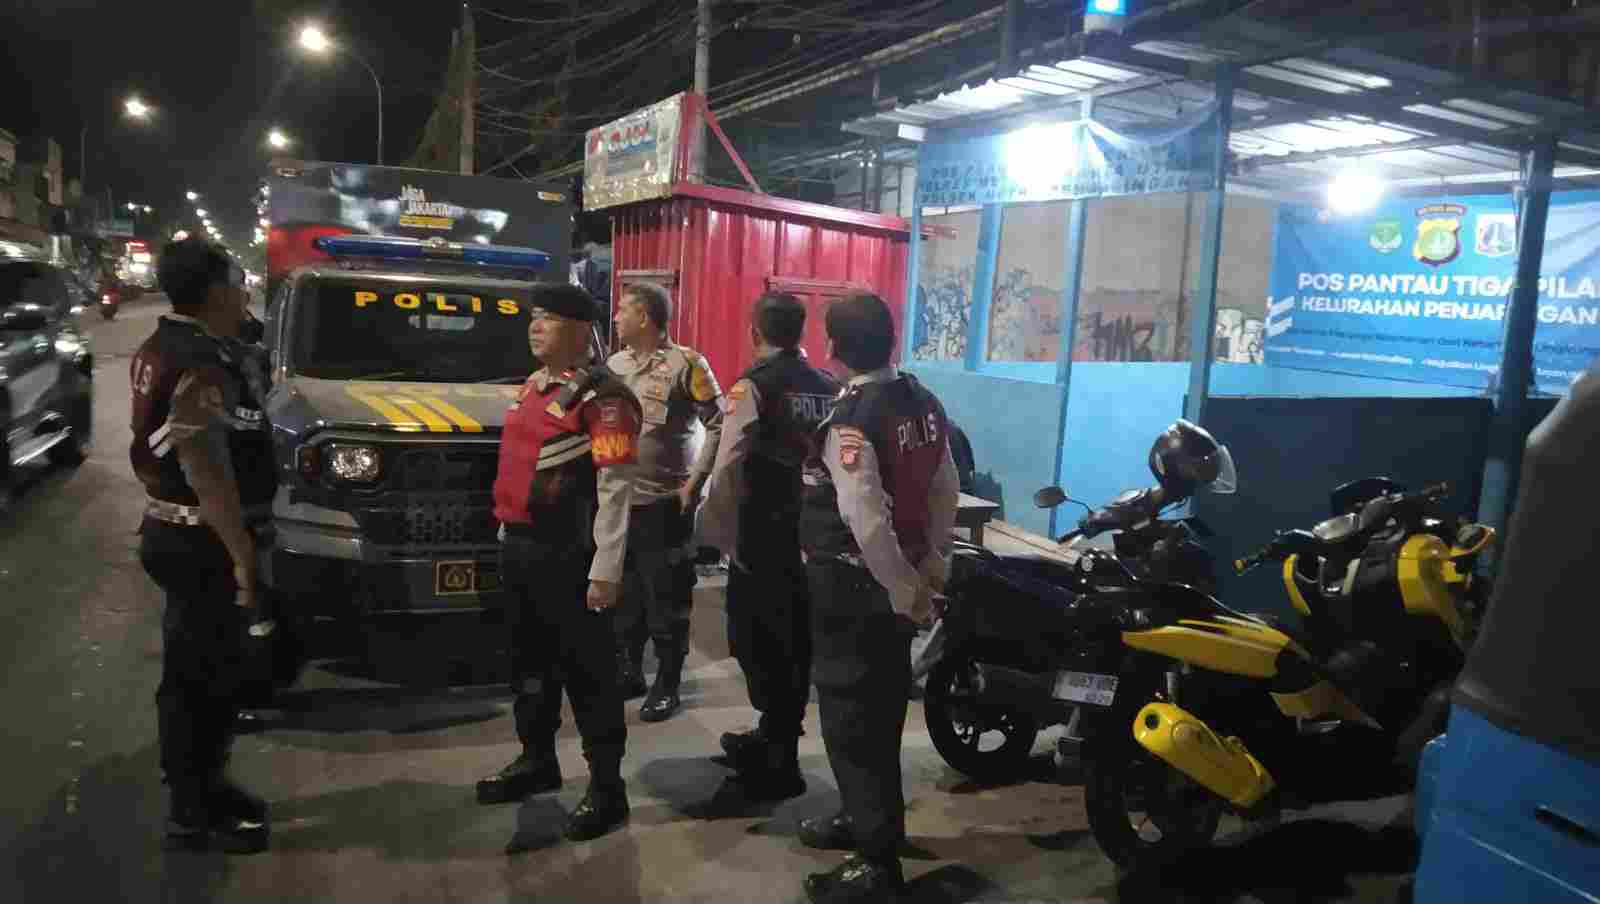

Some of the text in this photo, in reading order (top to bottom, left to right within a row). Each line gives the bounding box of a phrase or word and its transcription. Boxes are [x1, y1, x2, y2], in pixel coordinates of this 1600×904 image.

[1298, 272, 1345, 292] POS
[1347, 274, 1448, 297] PANTAU
[354, 291, 519, 315] POLIS
[1301, 296, 1599, 324] KELURAHAN PENJARGAN
